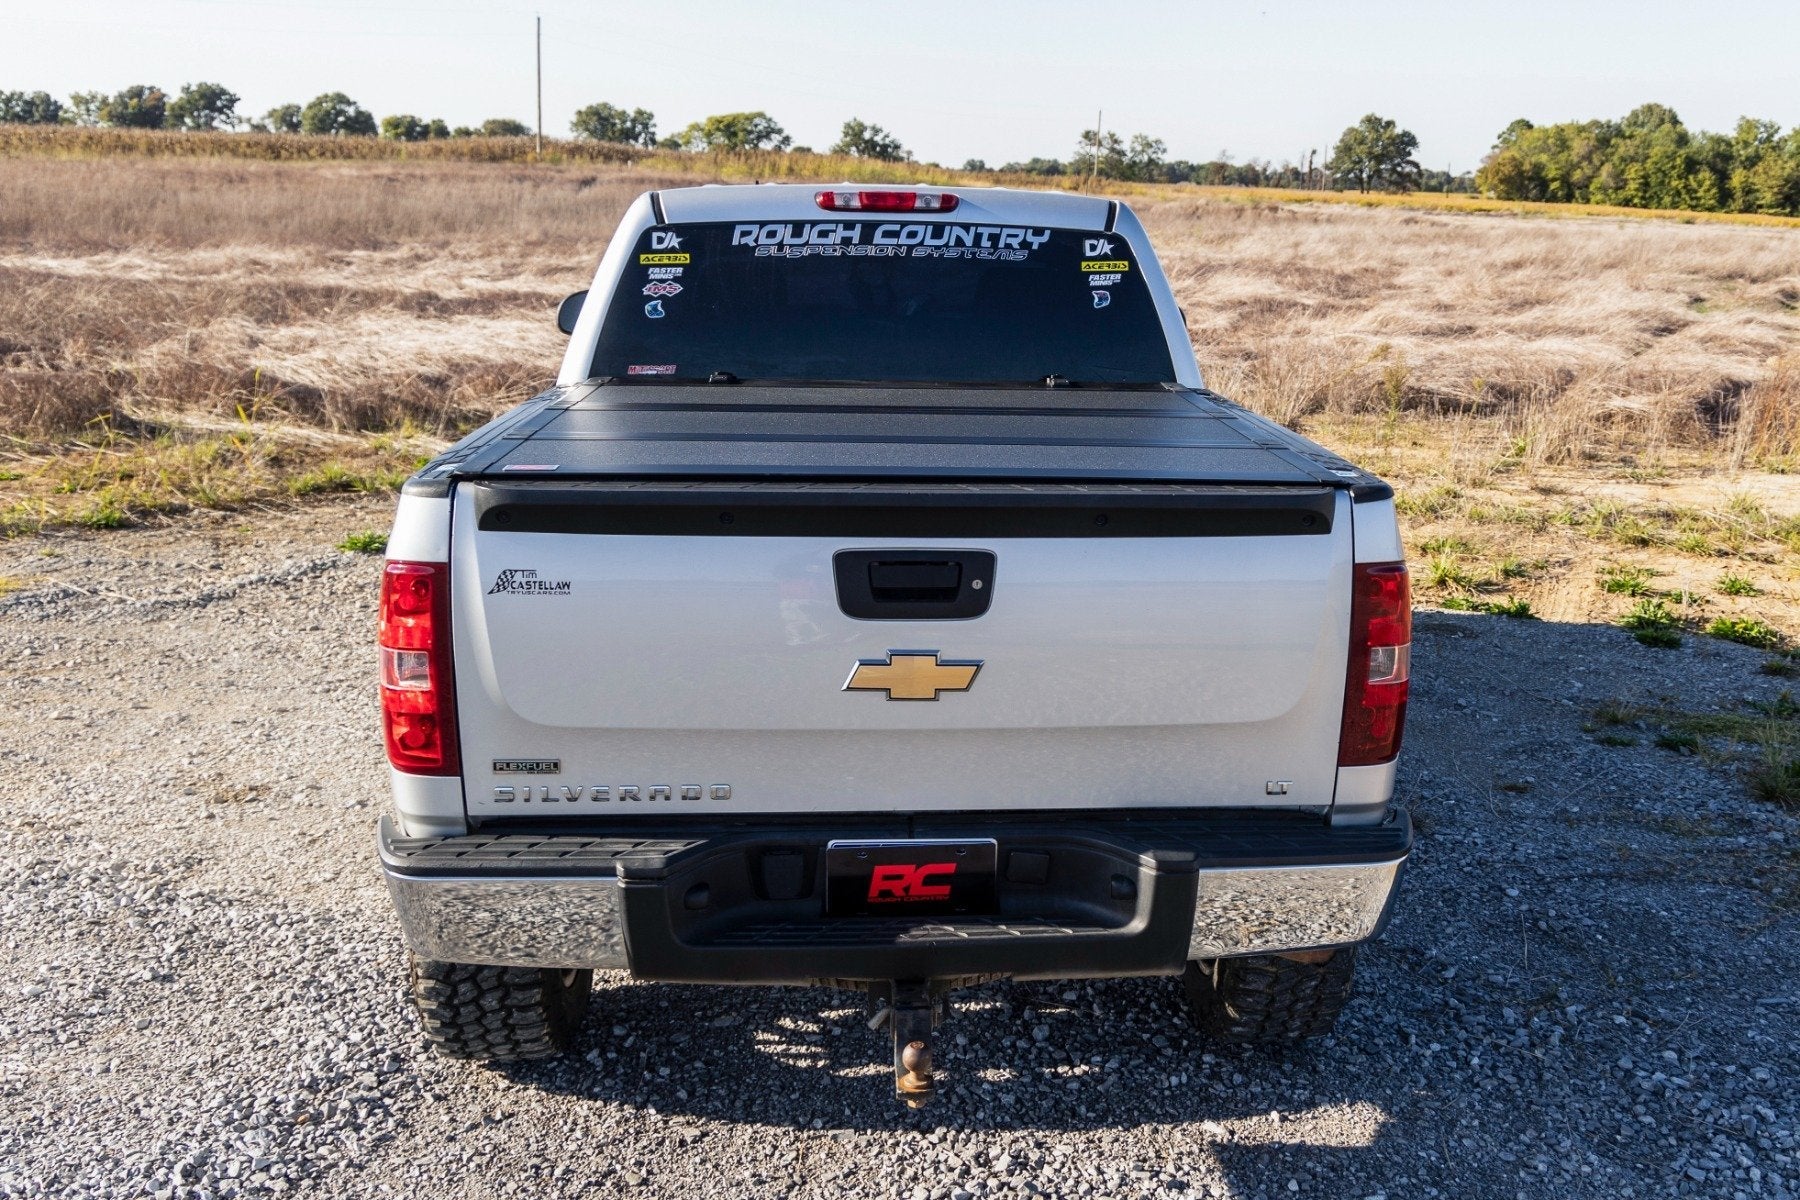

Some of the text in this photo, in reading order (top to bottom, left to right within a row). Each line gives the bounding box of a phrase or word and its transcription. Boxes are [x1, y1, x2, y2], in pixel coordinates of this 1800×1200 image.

[732, 223, 1050, 250] ROUGH COUNTRY
[755, 244, 1029, 261] SUSPENSION SYSTEMS
[1083, 262, 1127, 270] ACERBIS
[510, 581, 571, 590] CASTELLAW
[495, 762, 558, 771] FLEXFUEL
[494, 784, 732, 803] SILVERADO
[1266, 780, 1294, 796] LT
[868, 863, 957, 897] RC
